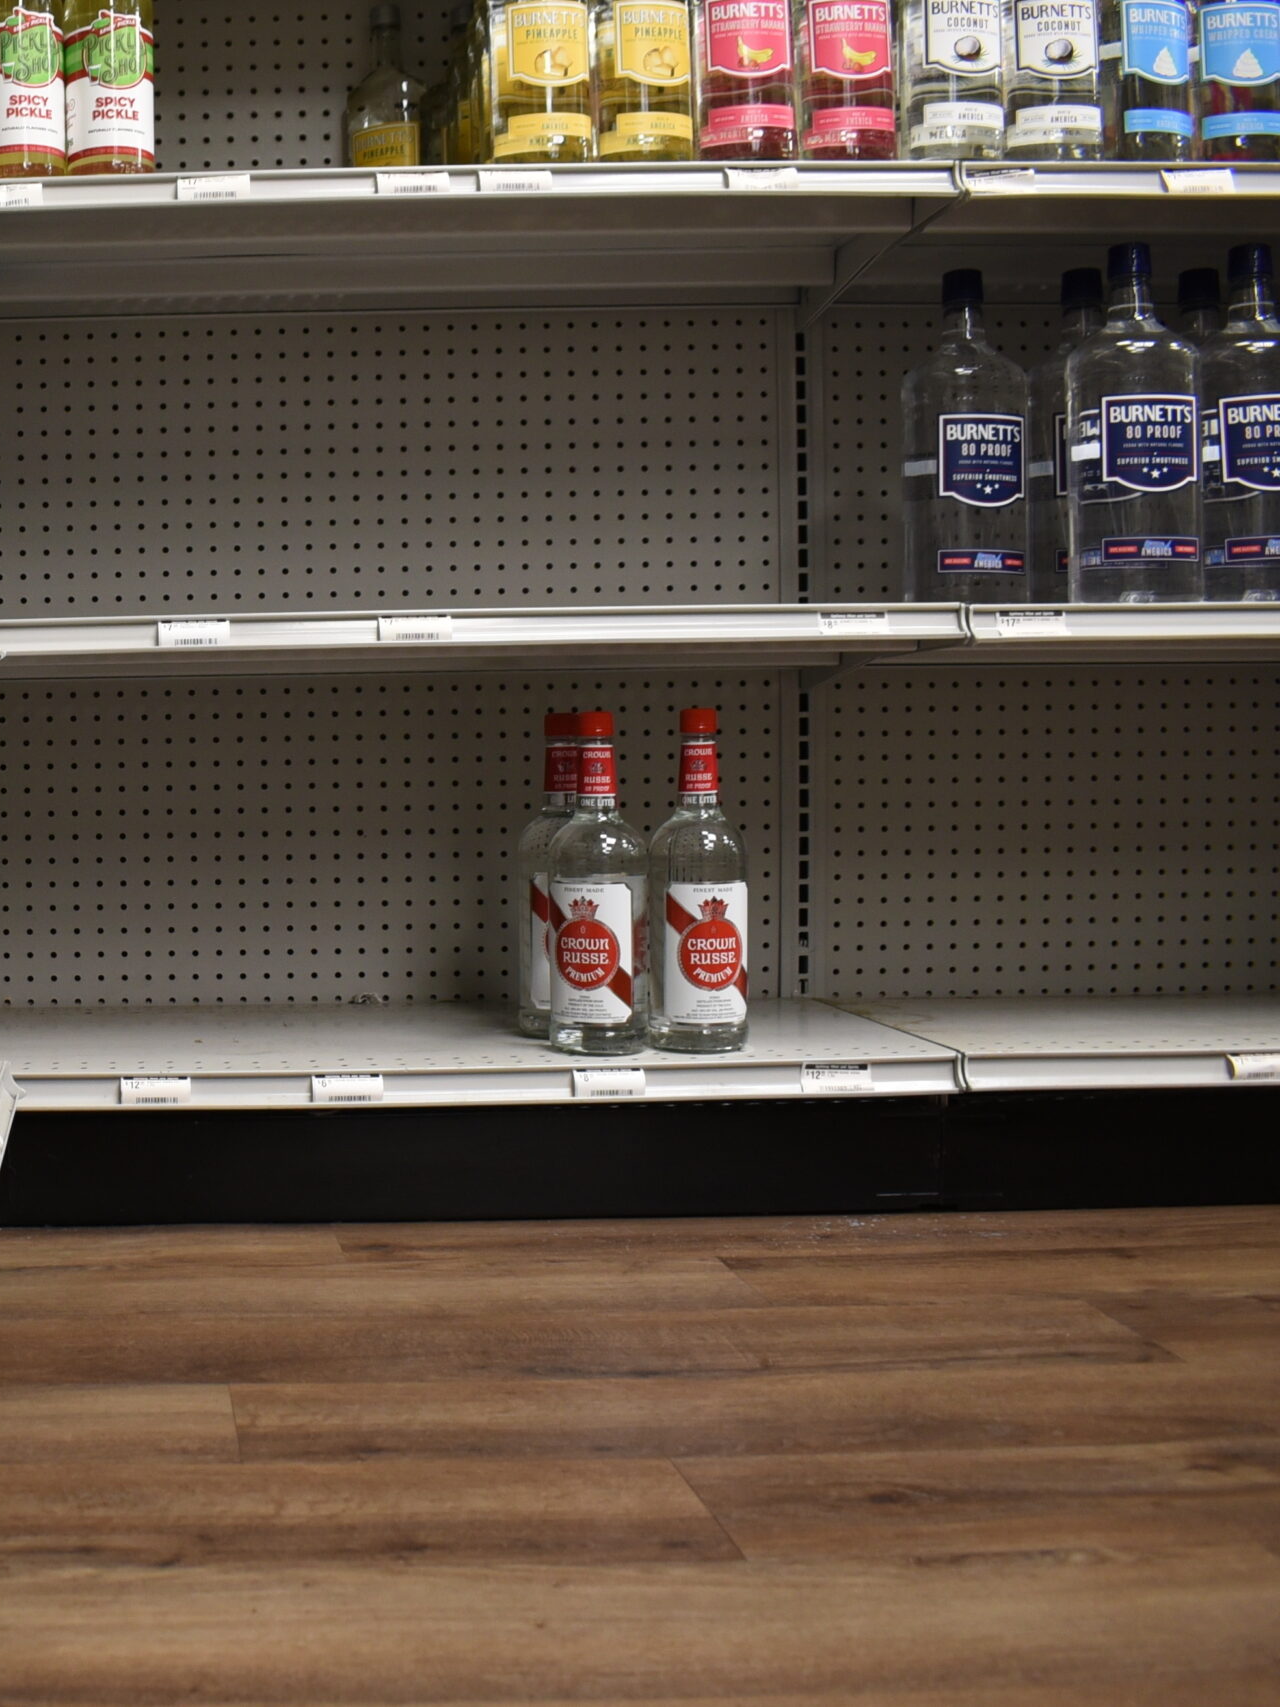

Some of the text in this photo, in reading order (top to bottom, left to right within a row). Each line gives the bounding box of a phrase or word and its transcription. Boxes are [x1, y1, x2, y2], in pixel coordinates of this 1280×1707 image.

[947, 17, 988, 29] COCONUT
[1037, 20, 1081, 32] COCONUT
[525, 26, 578, 40] PINEAPPLE
[634, 26, 683, 40] PINEAPPLE
[82, 33, 144, 66] PICKL
[16, 54, 53, 83] SHO
[102, 54, 141, 83] SHO
[9, 95, 49, 106] SPICY
[95, 97, 136, 109] SPICY
[6, 107, 53, 120] PICKLE
[92, 109, 140, 121] PICKLE
[740, 114, 769, 124] AMERICA
[958, 112, 984, 121] AMERICA
[1050, 115, 1078, 124] AMERICA
[846, 115, 873, 126] AMERICA
[1125, 425, 1183, 439] 80 PROOF
[1245, 425, 1261, 439] 80
[961, 442, 1013, 458] 80 PROOF
[1117, 456, 1189, 466] SUPERIOR SMOOTHNESS
[1236, 456, 1270, 466] SUPERIOR
[952, 472, 1018, 482] SUPERIOR SMOOTHNESS
[1141, 546, 1173, 557] AMERICA
[974, 558, 1003, 569] AMERICA
[582, 750, 611, 759] CROWN
[683, 748, 713, 756] CROWN
[583, 775, 611, 784] RUSSE
[685, 773, 713, 781] RUSSE
[580, 798, 596, 807] ONE
[682, 795, 698, 805] ONE
[560, 937, 610, 951] CROWN
[687, 937, 736, 951] CROWN
[563, 951, 609, 965] RUSSE
[690, 951, 736, 965] RUSSE
[565, 966, 606, 983] PREMIUM
[693, 966, 733, 983] PREMIUM
